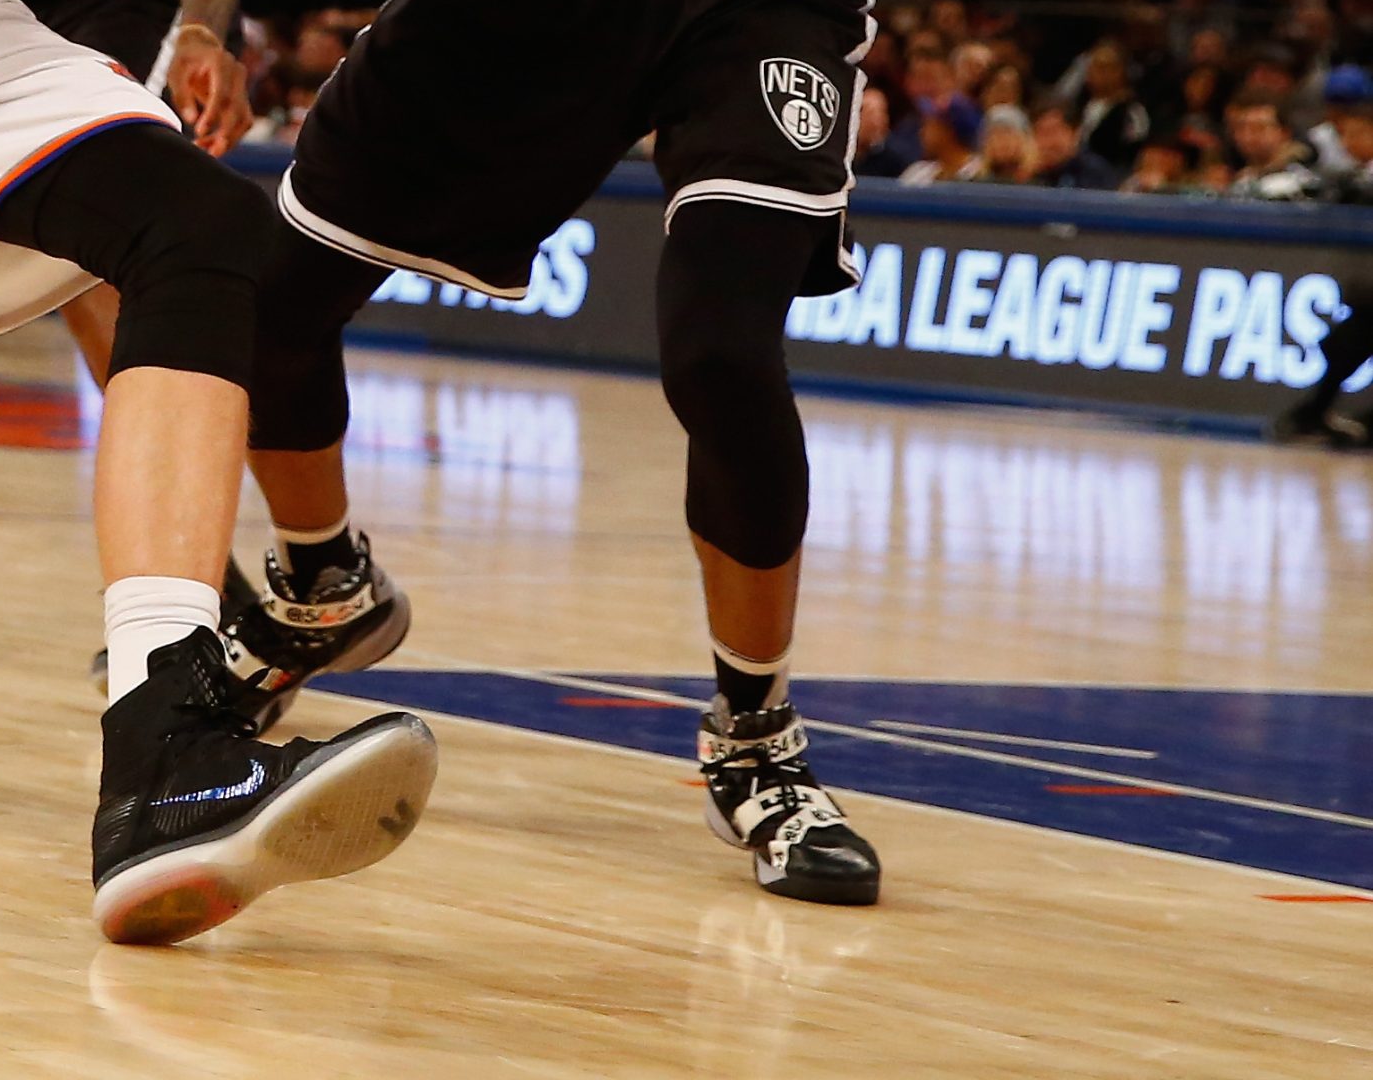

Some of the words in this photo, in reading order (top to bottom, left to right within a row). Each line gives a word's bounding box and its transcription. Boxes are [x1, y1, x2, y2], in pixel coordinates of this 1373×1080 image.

[767, 62, 835, 118] NETS
[797, 106, 810, 136] B
[905, 246, 1182, 374] LEAGUE
[1182, 267, 1373, 394] PAS
